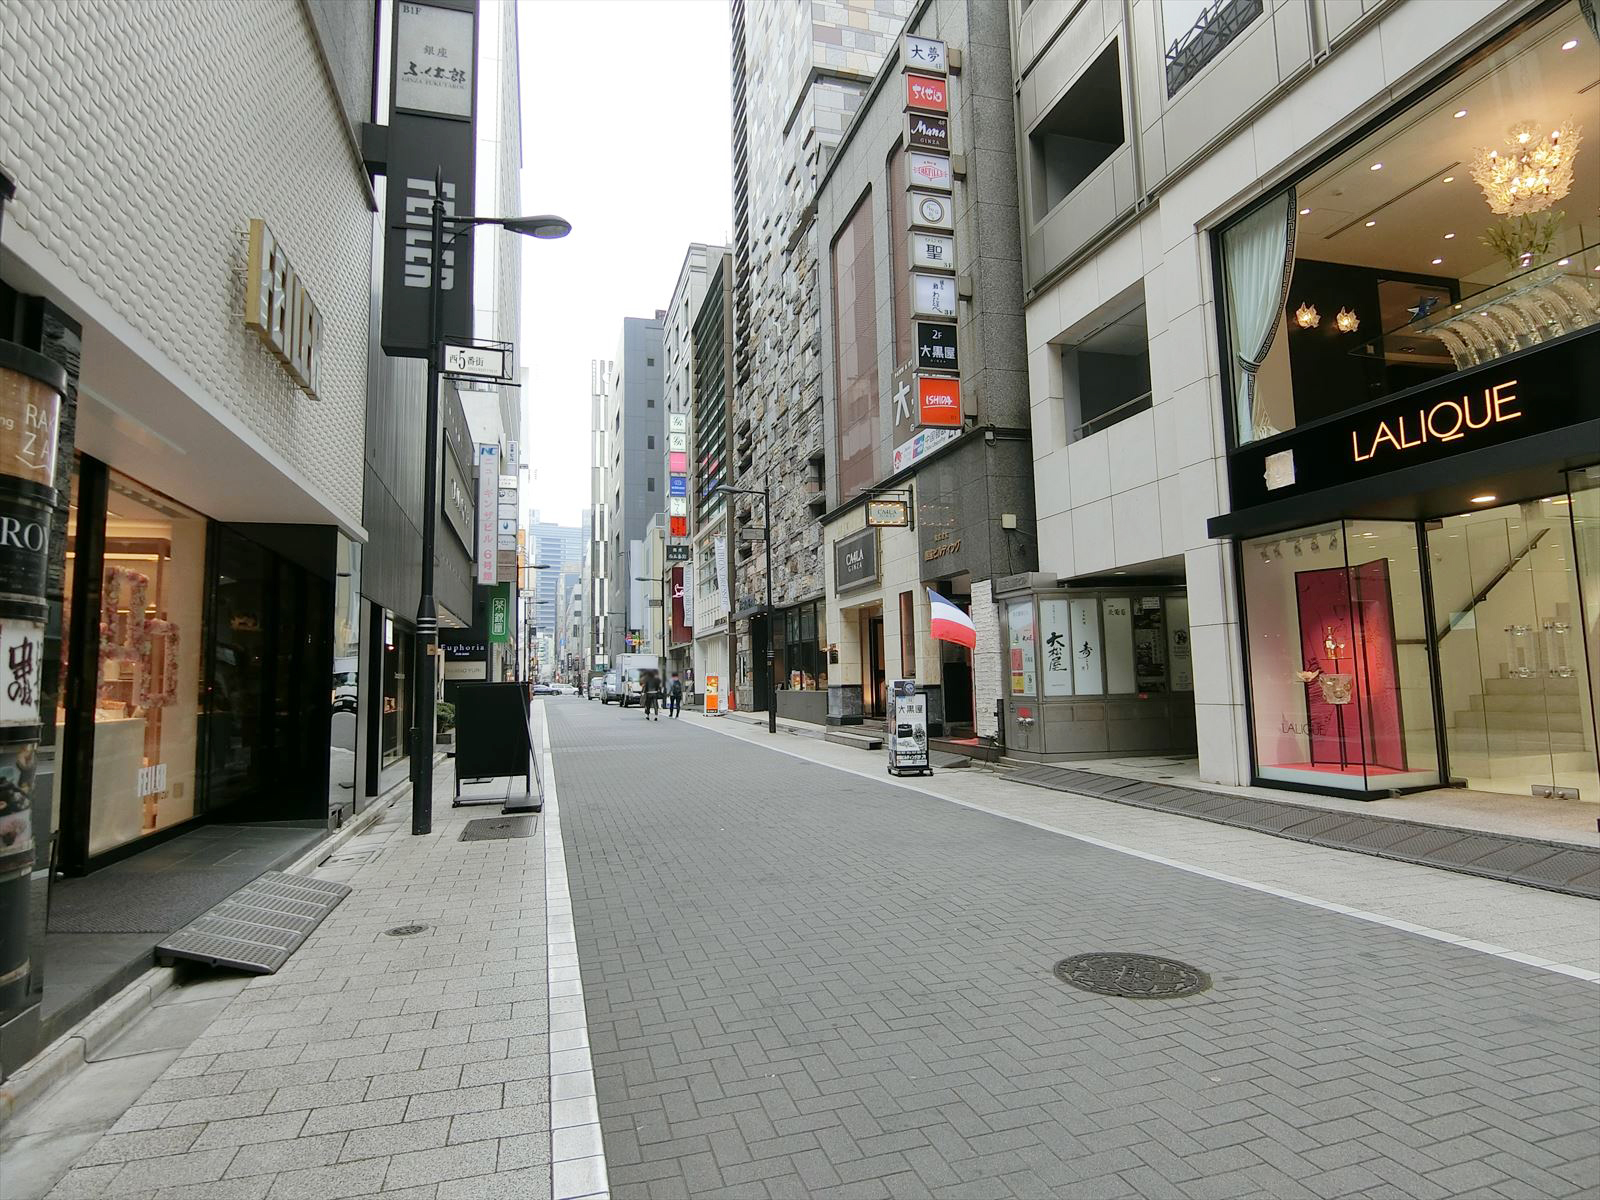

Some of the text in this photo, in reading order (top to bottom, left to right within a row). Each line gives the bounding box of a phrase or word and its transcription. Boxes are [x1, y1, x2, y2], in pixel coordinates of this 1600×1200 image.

[403, 4, 421, 15] B1F
[423, 45, 448, 58] 銀座
[911, 44, 940, 62] 大夢
[910, 120, 945, 138] Mana
[919, 137, 940, 145] GINZA
[926, 243, 943, 260] 聖
[932, 329, 942, 339] 2F
[920, 344, 956, 360] 大黒屋
[449, 350, 484, 370] 西5番街
[925, 395, 953, 405] ISHIDA
[1353, 380, 1522, 462] LALIQUE
[440, 644, 485, 653] Euphoria
[1046, 631, 1068, 672] 大松屋
[898, 705, 923, 714] 大黒屋
